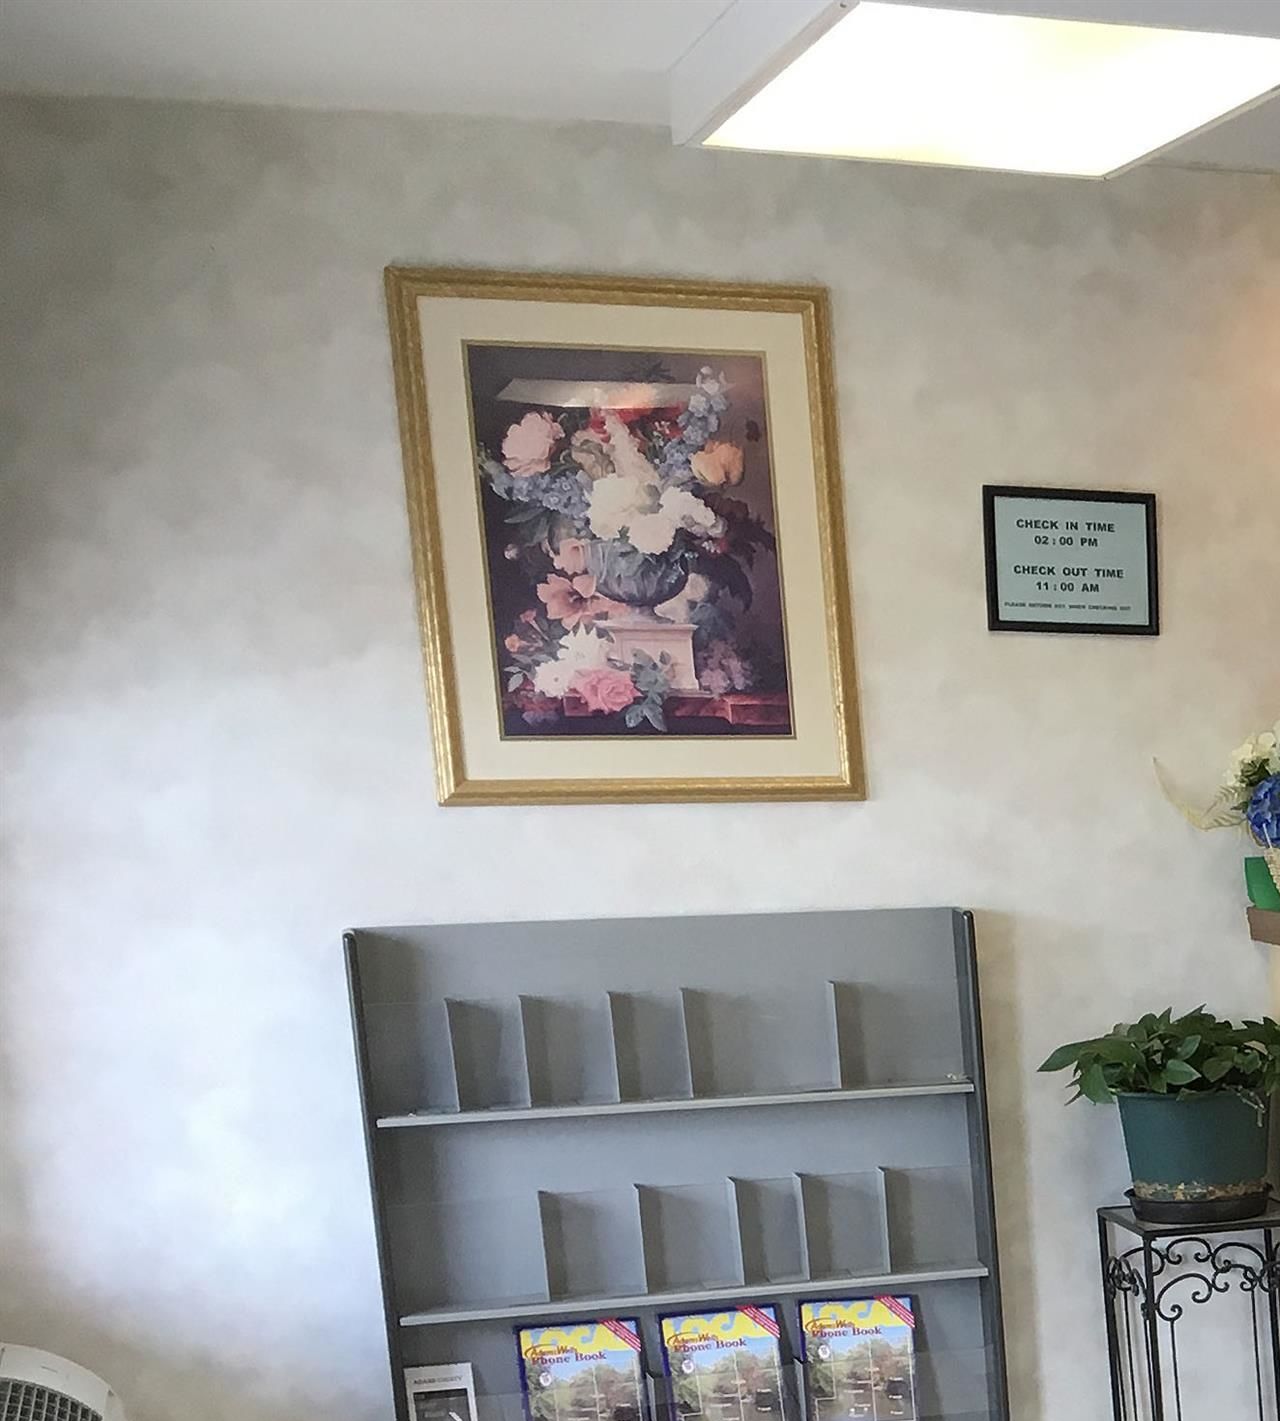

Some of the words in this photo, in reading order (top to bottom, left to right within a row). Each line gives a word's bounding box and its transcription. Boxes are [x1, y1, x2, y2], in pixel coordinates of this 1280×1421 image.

[1016, 518, 1059, 530] CHECK
[1066, 521, 1079, 531] IN
[1085, 522, 1116, 533] TIME
[1080, 537, 1099, 547] PM
[1013, 564, 1056, 576] CHECK
[1062, 567, 1088, 577] OUT
[1094, 568, 1124, 579] TIME
[1081, 582, 1100, 593] AM
[801, 1301, 908, 1333] LOCA
[662, 1308, 772, 1347] LOCA
[811, 1330, 848, 1338] Phone
[852, 1326, 882, 1336] Book
[520, 1323, 635, 1359] LOCA
[674, 1343, 712, 1352] Phone
[716, 1338, 747, 1348] Book
[531, 1356, 570, 1365] Phone
[575, 1351, 607, 1361] Book
